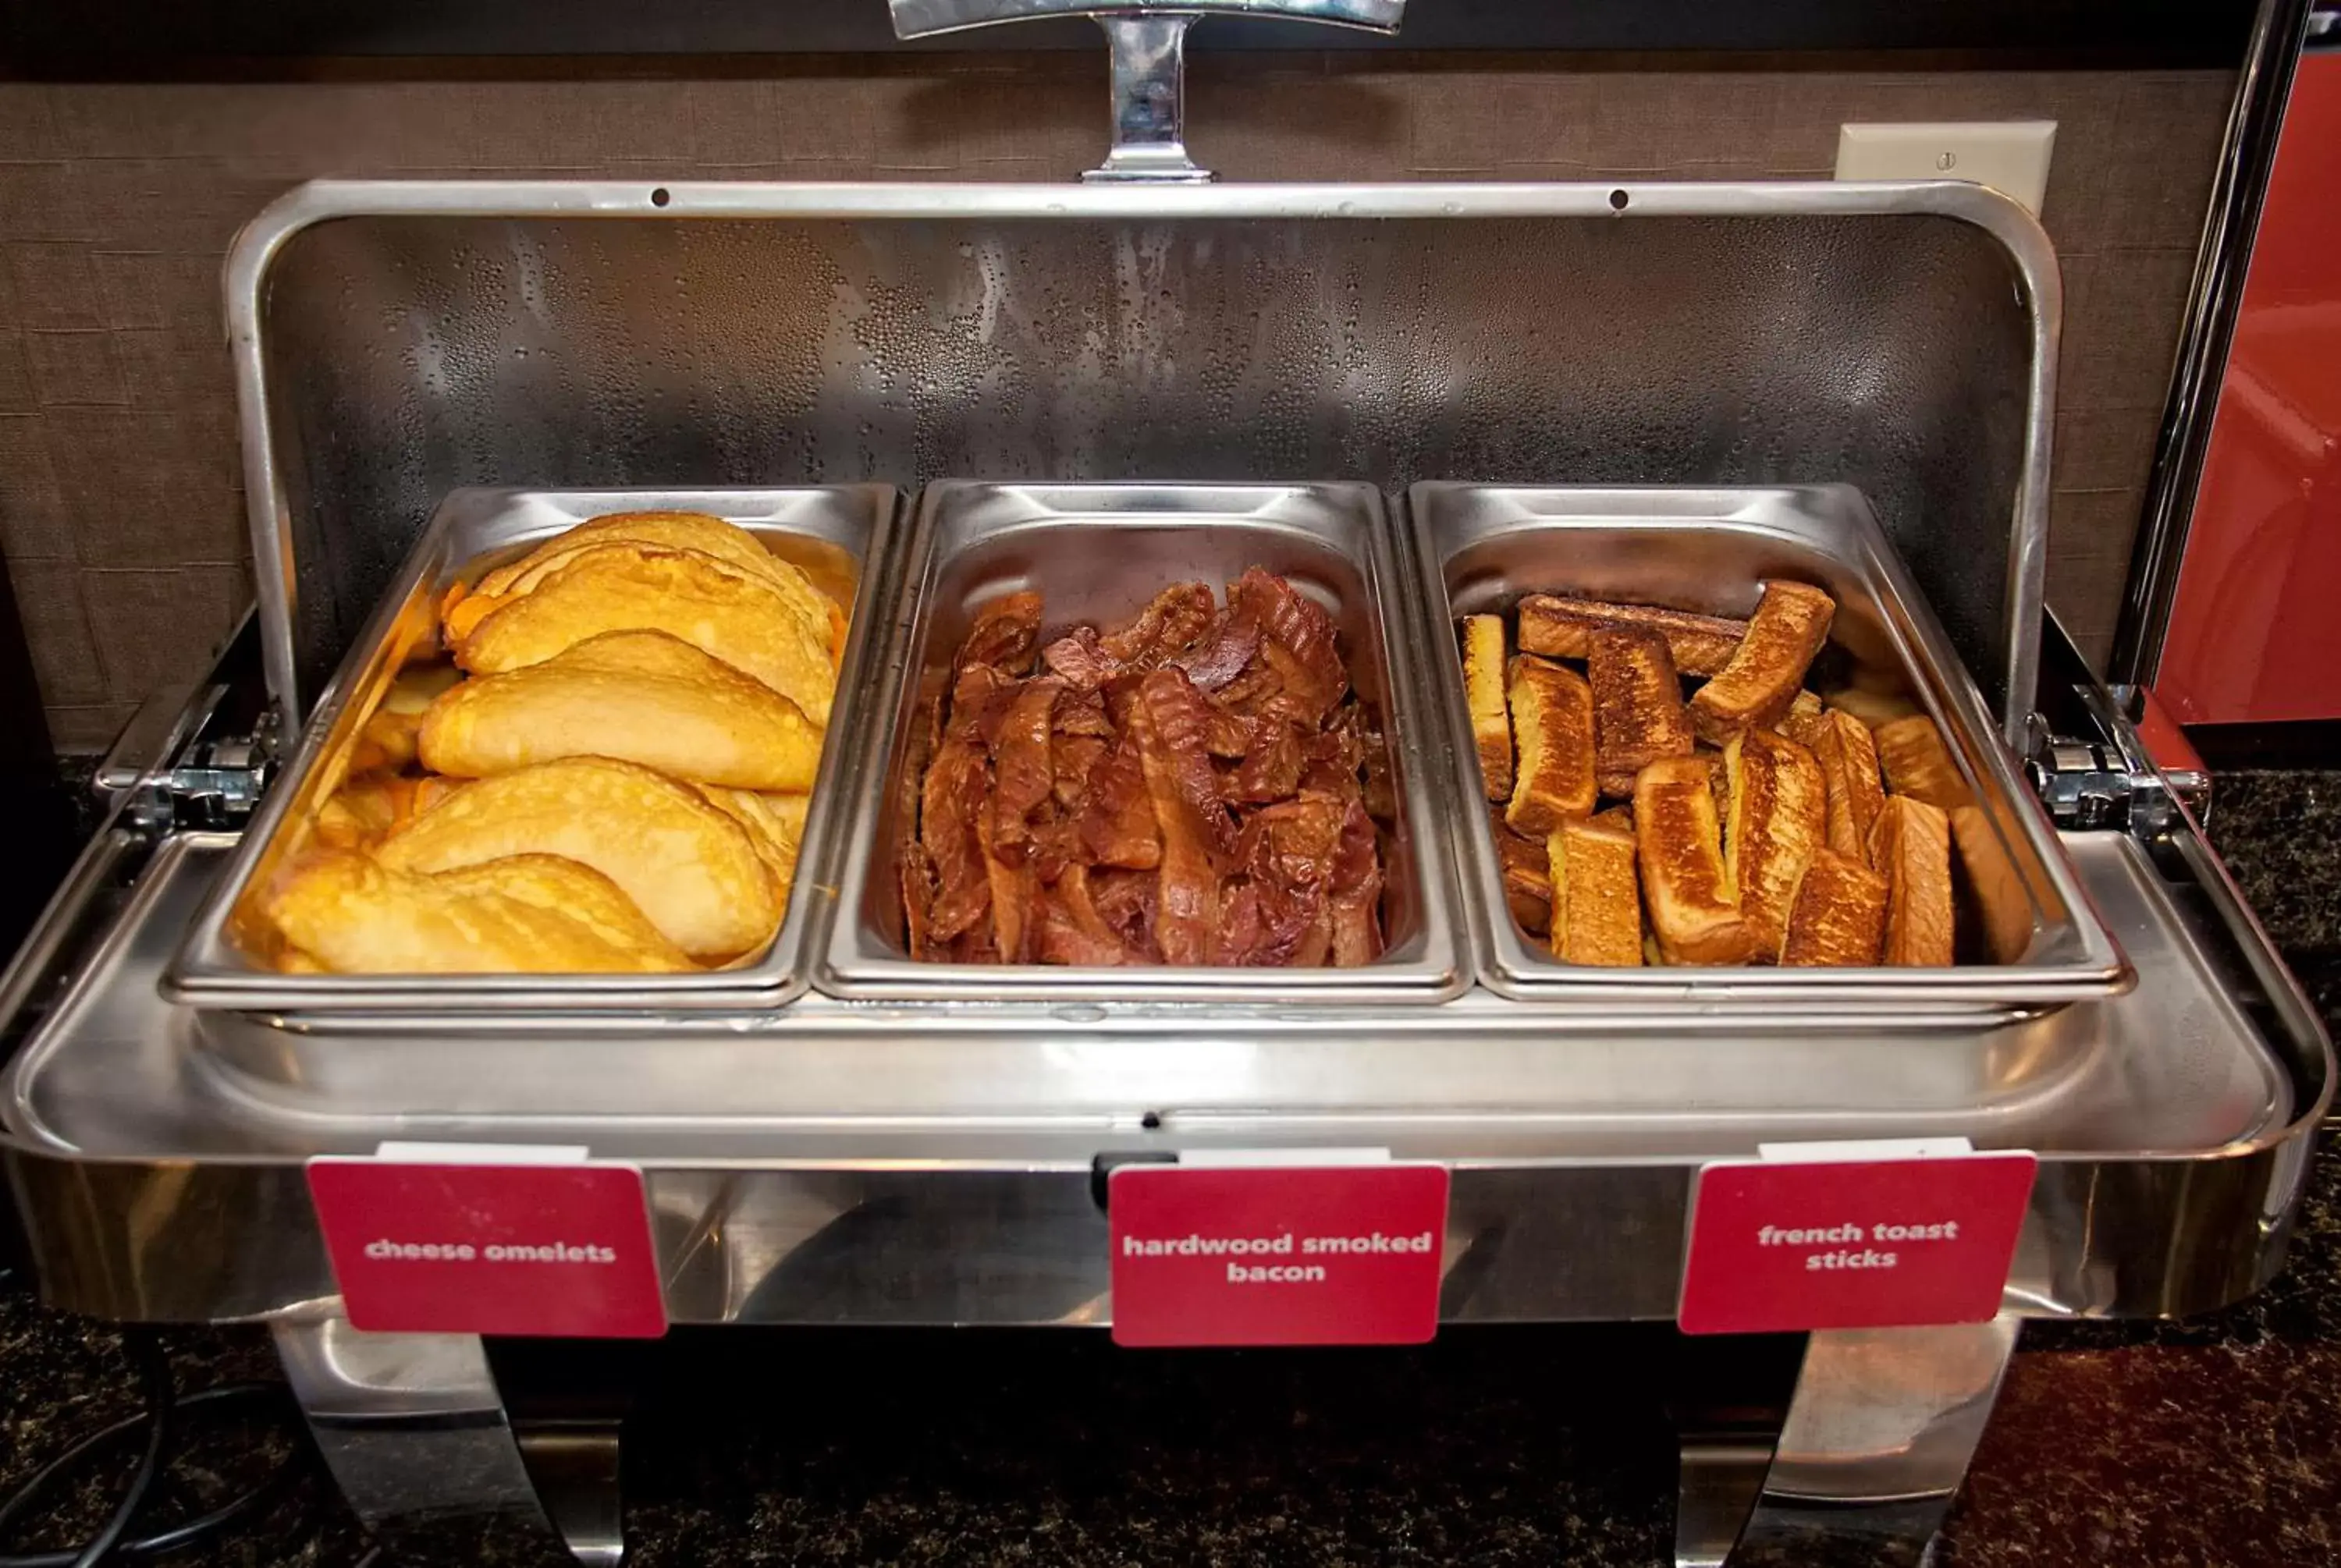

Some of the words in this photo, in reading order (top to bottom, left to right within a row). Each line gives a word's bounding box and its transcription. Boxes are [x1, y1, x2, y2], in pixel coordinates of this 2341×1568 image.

[1758, 1222, 1863, 1244] french
[1873, 1221, 1958, 1240] toast
[366, 1240, 475, 1259] cheese
[484, 1242, 616, 1262] omelets
[1123, 1233, 1293, 1256] hardwood
[1302, 1232, 1432, 1254] smoked
[1806, 1249, 1896, 1269] sticks
[1227, 1262, 1325, 1282] bacon
